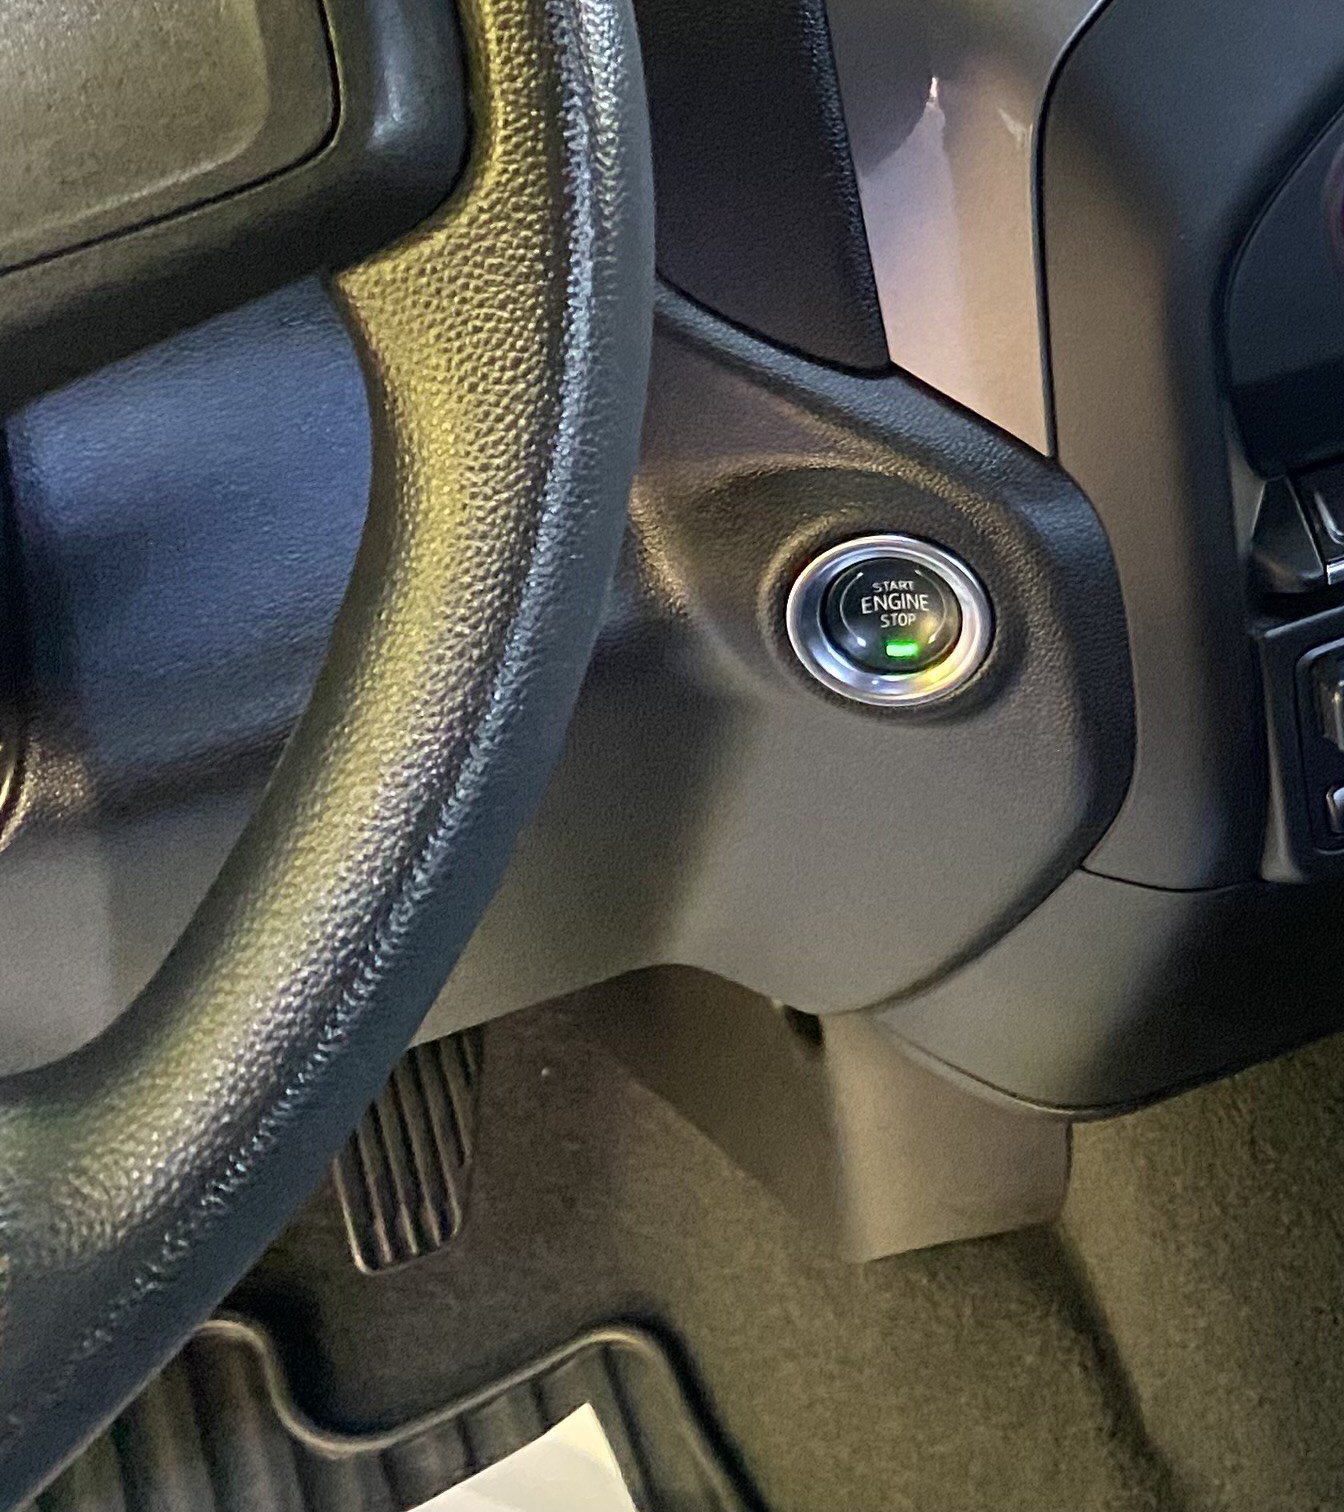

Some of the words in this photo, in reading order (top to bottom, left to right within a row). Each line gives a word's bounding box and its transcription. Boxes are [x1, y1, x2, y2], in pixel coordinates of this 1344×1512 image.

[872, 580, 916, 594] START
[861, 592, 930, 615] ENGINE
[880, 612, 917, 628] STOP
